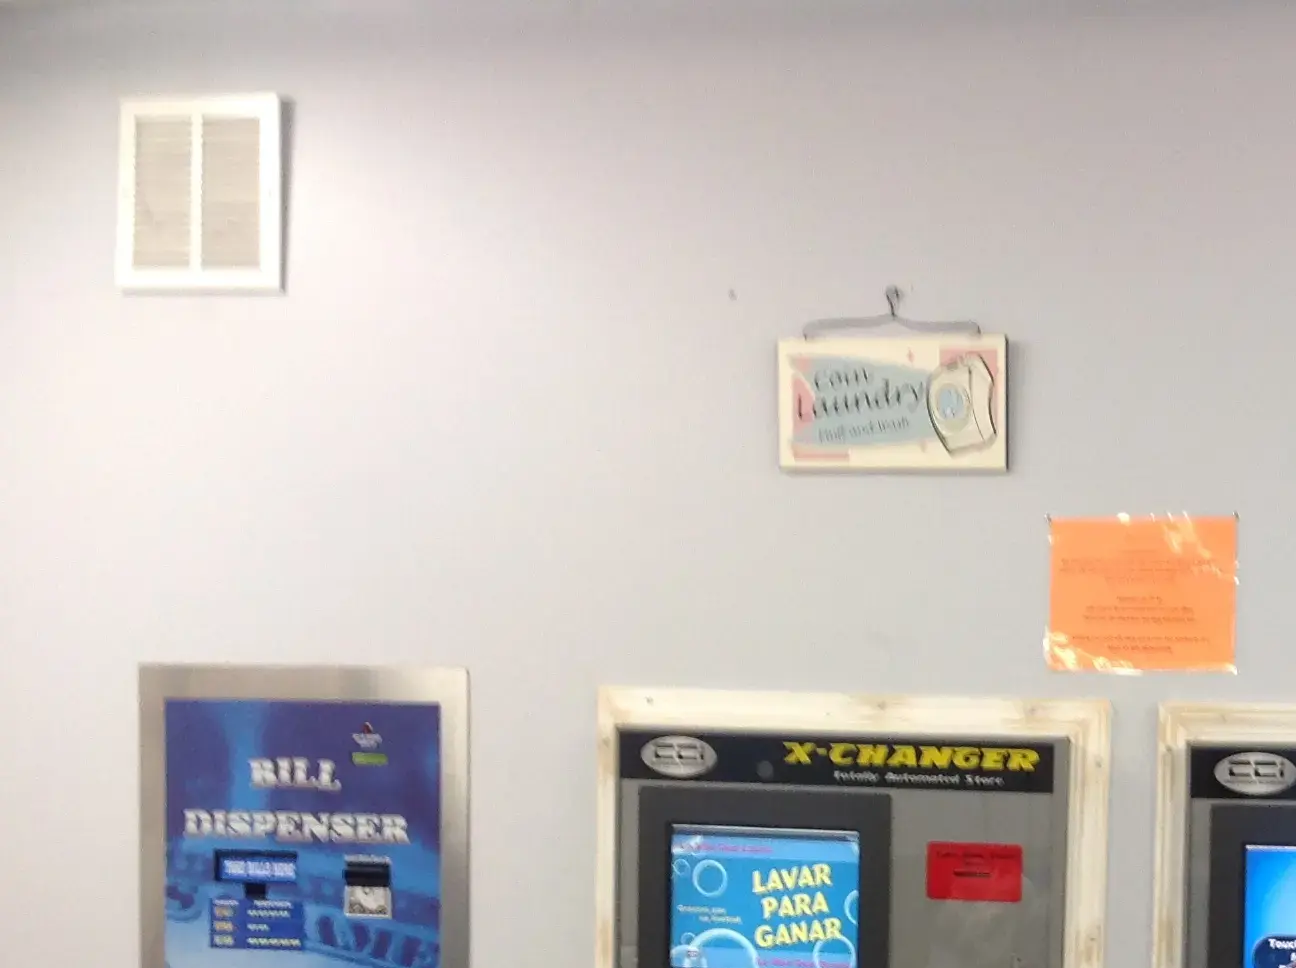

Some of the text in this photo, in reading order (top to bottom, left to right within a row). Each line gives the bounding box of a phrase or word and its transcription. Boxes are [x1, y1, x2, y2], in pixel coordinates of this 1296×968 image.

[783, 741, 1040, 772] X-CHANGER
[248, 756, 343, 792] BILL
[884, 771, 961, 785] Automated
[183, 808, 412, 844] DISPENSER
[752, 863, 834, 895] LAVAR
[761, 890, 830, 921] PARA
[754, 917, 843, 948] GANAR
